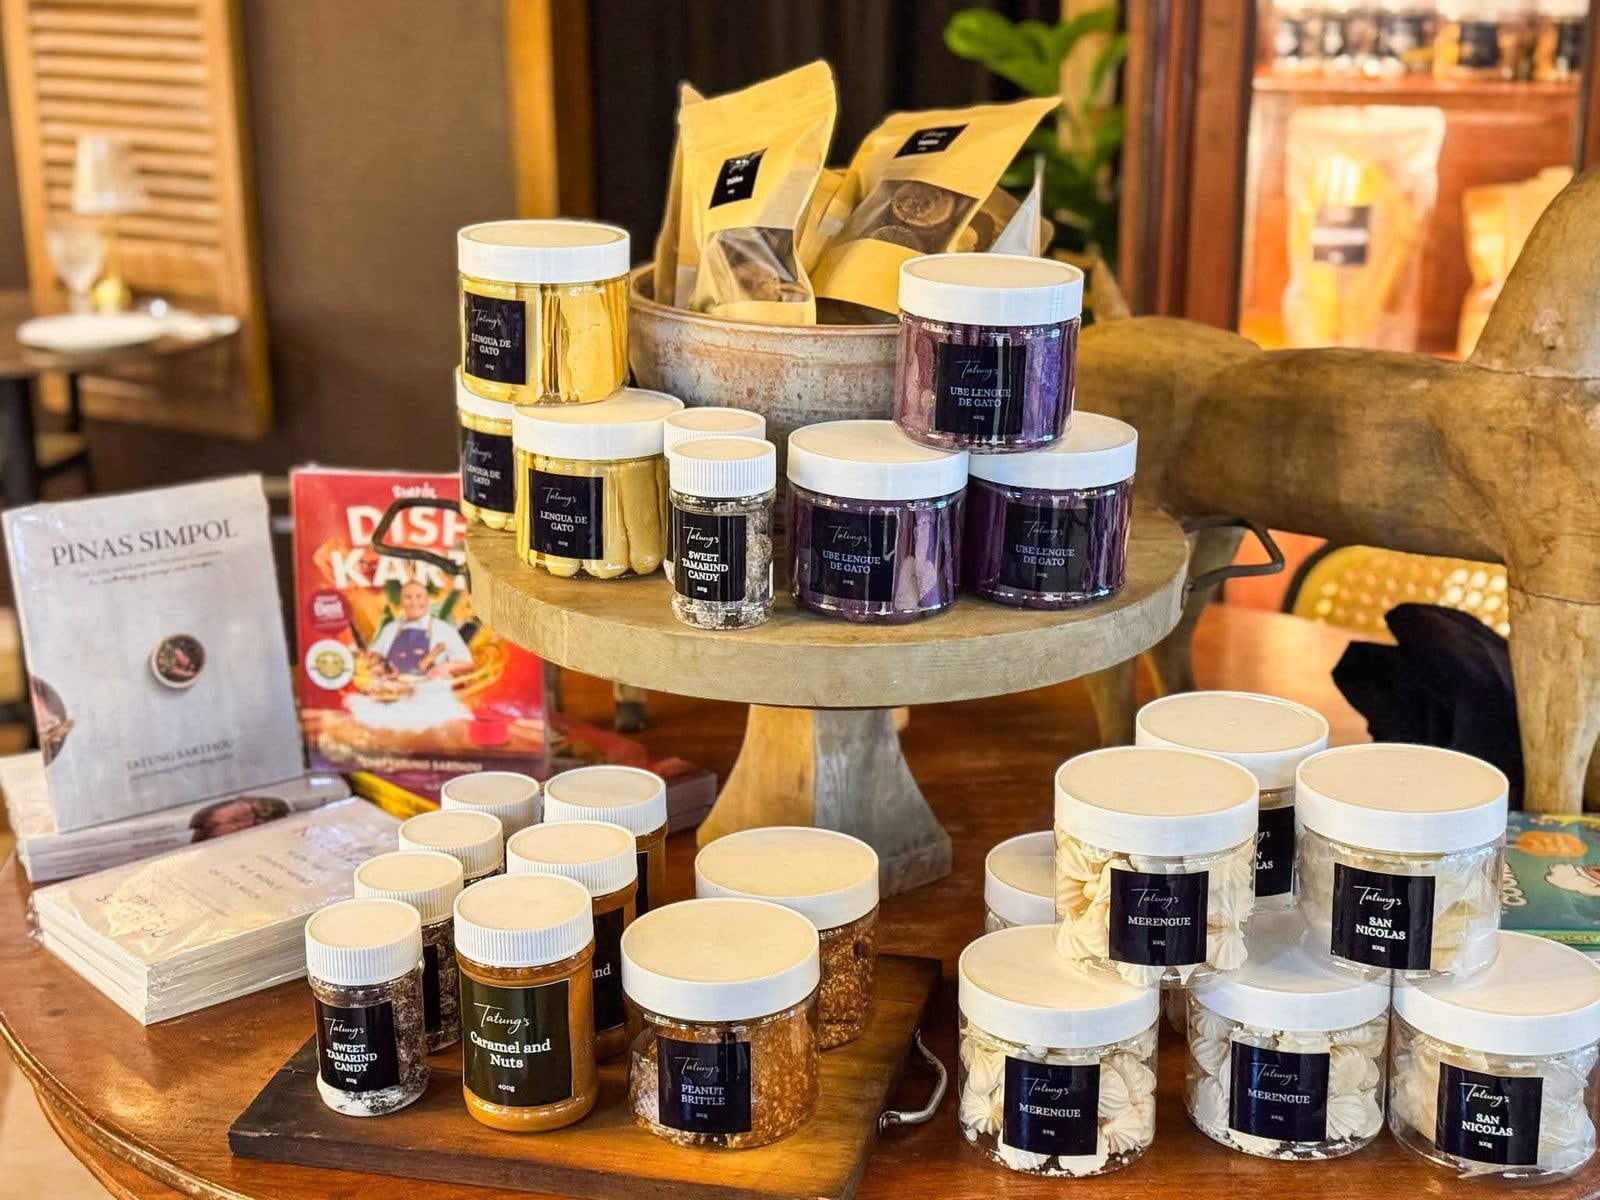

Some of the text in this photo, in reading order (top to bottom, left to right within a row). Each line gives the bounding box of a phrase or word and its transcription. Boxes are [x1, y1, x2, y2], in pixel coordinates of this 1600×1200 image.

[471, 333, 512, 349] LENGUA DE
[479, 345, 500, 356] GATO
[950, 386, 1012, 398] UBE LENGUE
[958, 397, 1002, 408] DE GATO
[473, 476, 491, 486] GATO
[489, 469, 501, 480] DE
[539, 510, 588, 525] LENGUA DE
[550, 522, 574, 532] GATO
[51, 534, 134, 567] PINAS
[138, 518, 238, 553] SIMPOL
[683, 526, 720, 549] Tatung's
[826, 525, 869, 547] Tatung's
[688, 550, 720, 562] SWEET
[822, 549, 881, 565] UBE LENGUE
[1015, 544, 1076, 557] UBE LENGUE
[681, 558, 729, 573] TAMARIND
[1022, 554, 1065, 566] DE GATO
[829, 562, 871, 574] DE GATO
[688, 570, 720, 582] CANDY
[1130, 888, 1179, 910] Tatung's
[1353, 885, 1403, 911] Tatung's
[1127, 915, 1191, 927] MERENGUE
[1369, 916, 1393, 928] SAN
[1355, 924, 1406, 940] NICOLAS
[1371, 944, 1386, 952] 100g
[473, 1002, 530, 1035] Tatung's
[324, 1017, 365, 1040] Tatung's
[332, 1041, 366, 1053] SWEET
[470, 1031, 552, 1054] Caramel and
[326, 1048, 378, 1063] TAMARIND
[489, 1053, 524, 1069] Nuts
[334, 1061, 369, 1073] CANDY
[674, 1056, 720, 1079] Tatung's
[1250, 1062, 1299, 1086] Tatung's
[497, 1083, 516, 1093] 400g
[681, 1083, 725, 1096] PEANUT
[1021, 1077, 1070, 1100] Tatung's
[1247, 1087, 1311, 1104] MERENGUE
[1459, 1082, 1510, 1108] Tatung's
[681, 1094, 726, 1106] BRITTLE
[1018, 1102, 1082, 1118] MERENGUE
[1475, 1113, 1501, 1125] SAN
[1461, 1120, 1515, 1137] NICOLAS
[1478, 1140, 1494, 1149] 100g
